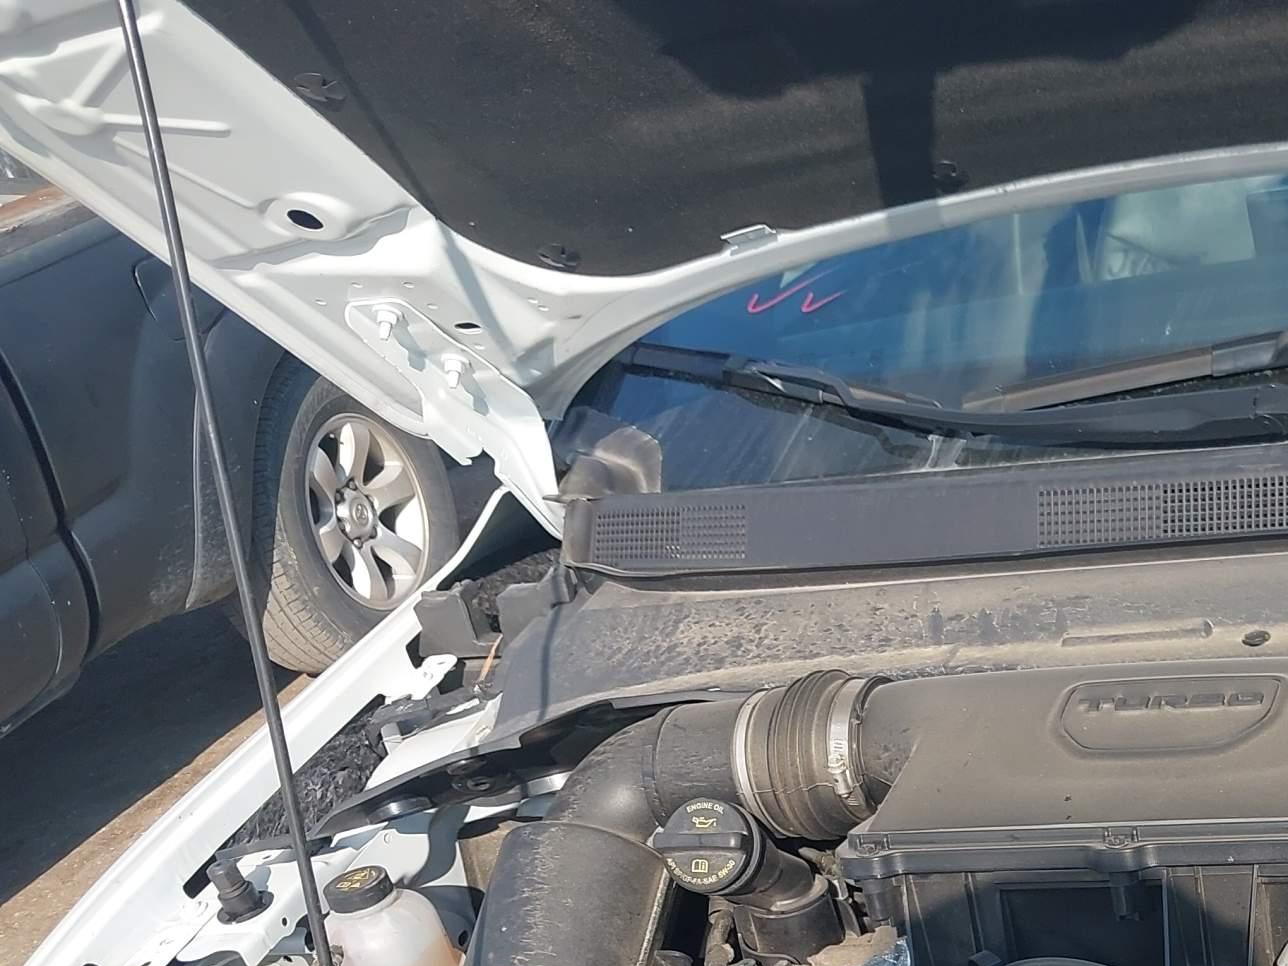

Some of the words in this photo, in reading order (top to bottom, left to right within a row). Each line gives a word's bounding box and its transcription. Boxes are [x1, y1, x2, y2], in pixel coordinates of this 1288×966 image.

[1079, 692, 1265, 713] TURBO
[686, 802, 713, 813] ENGINE
[713, 803, 725, 815] OIL
